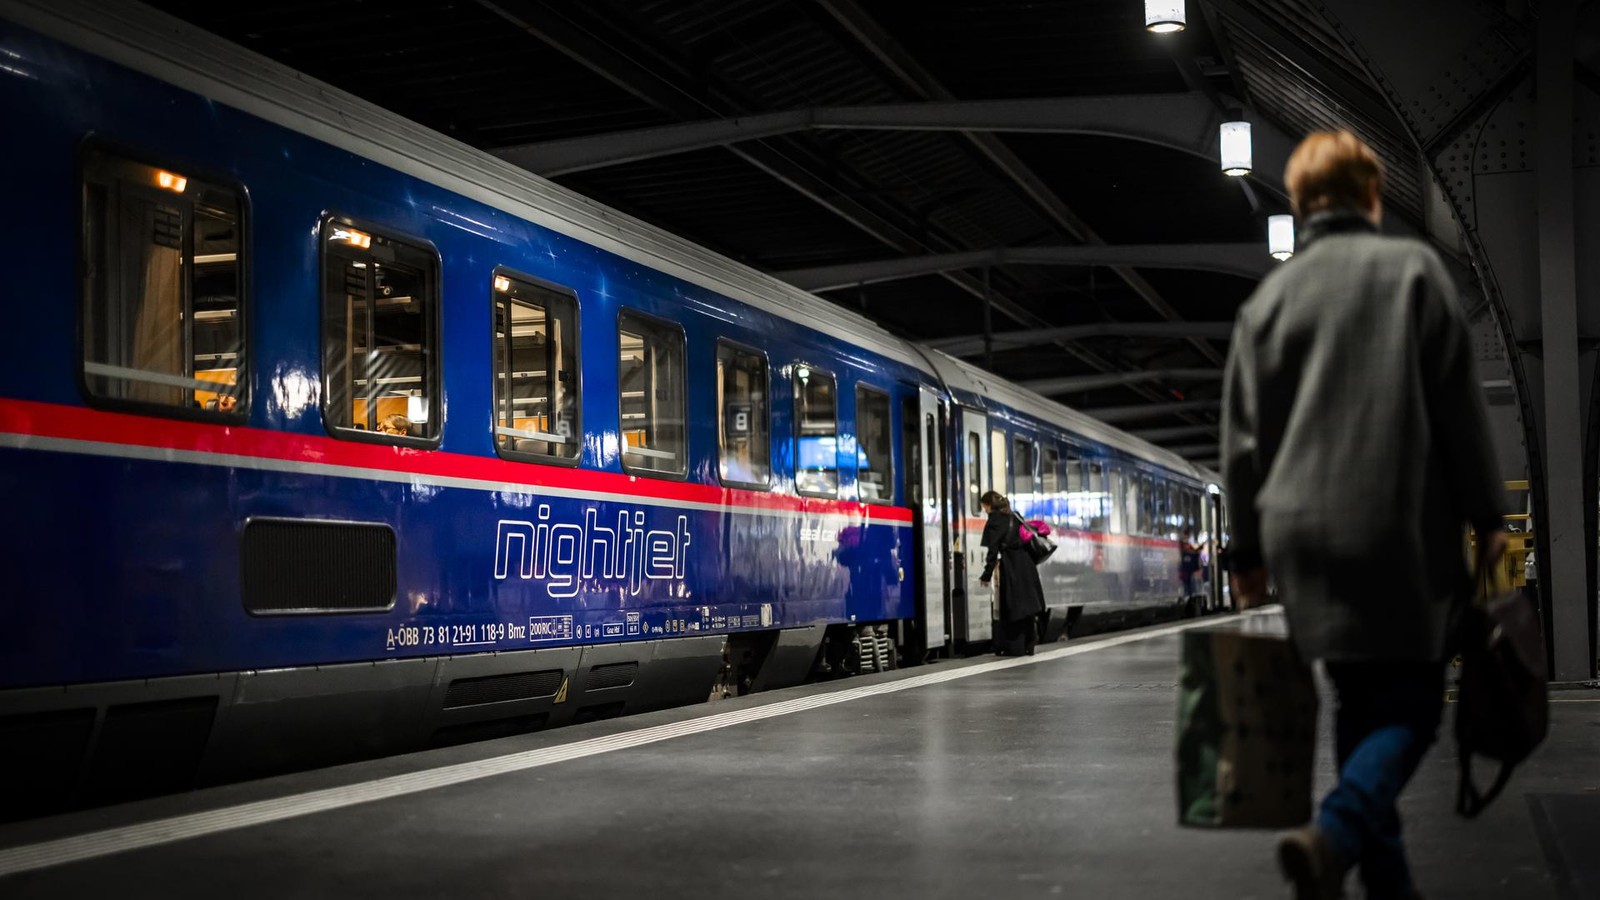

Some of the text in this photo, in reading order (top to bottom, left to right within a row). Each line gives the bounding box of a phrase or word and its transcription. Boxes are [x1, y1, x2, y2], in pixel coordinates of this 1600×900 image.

[494, 504, 690, 598] nightjet
[386, 622, 526, 648] A-ÖBB 73 81 21-91 118-9 Bmz
[531, 623, 542, 635] 200
